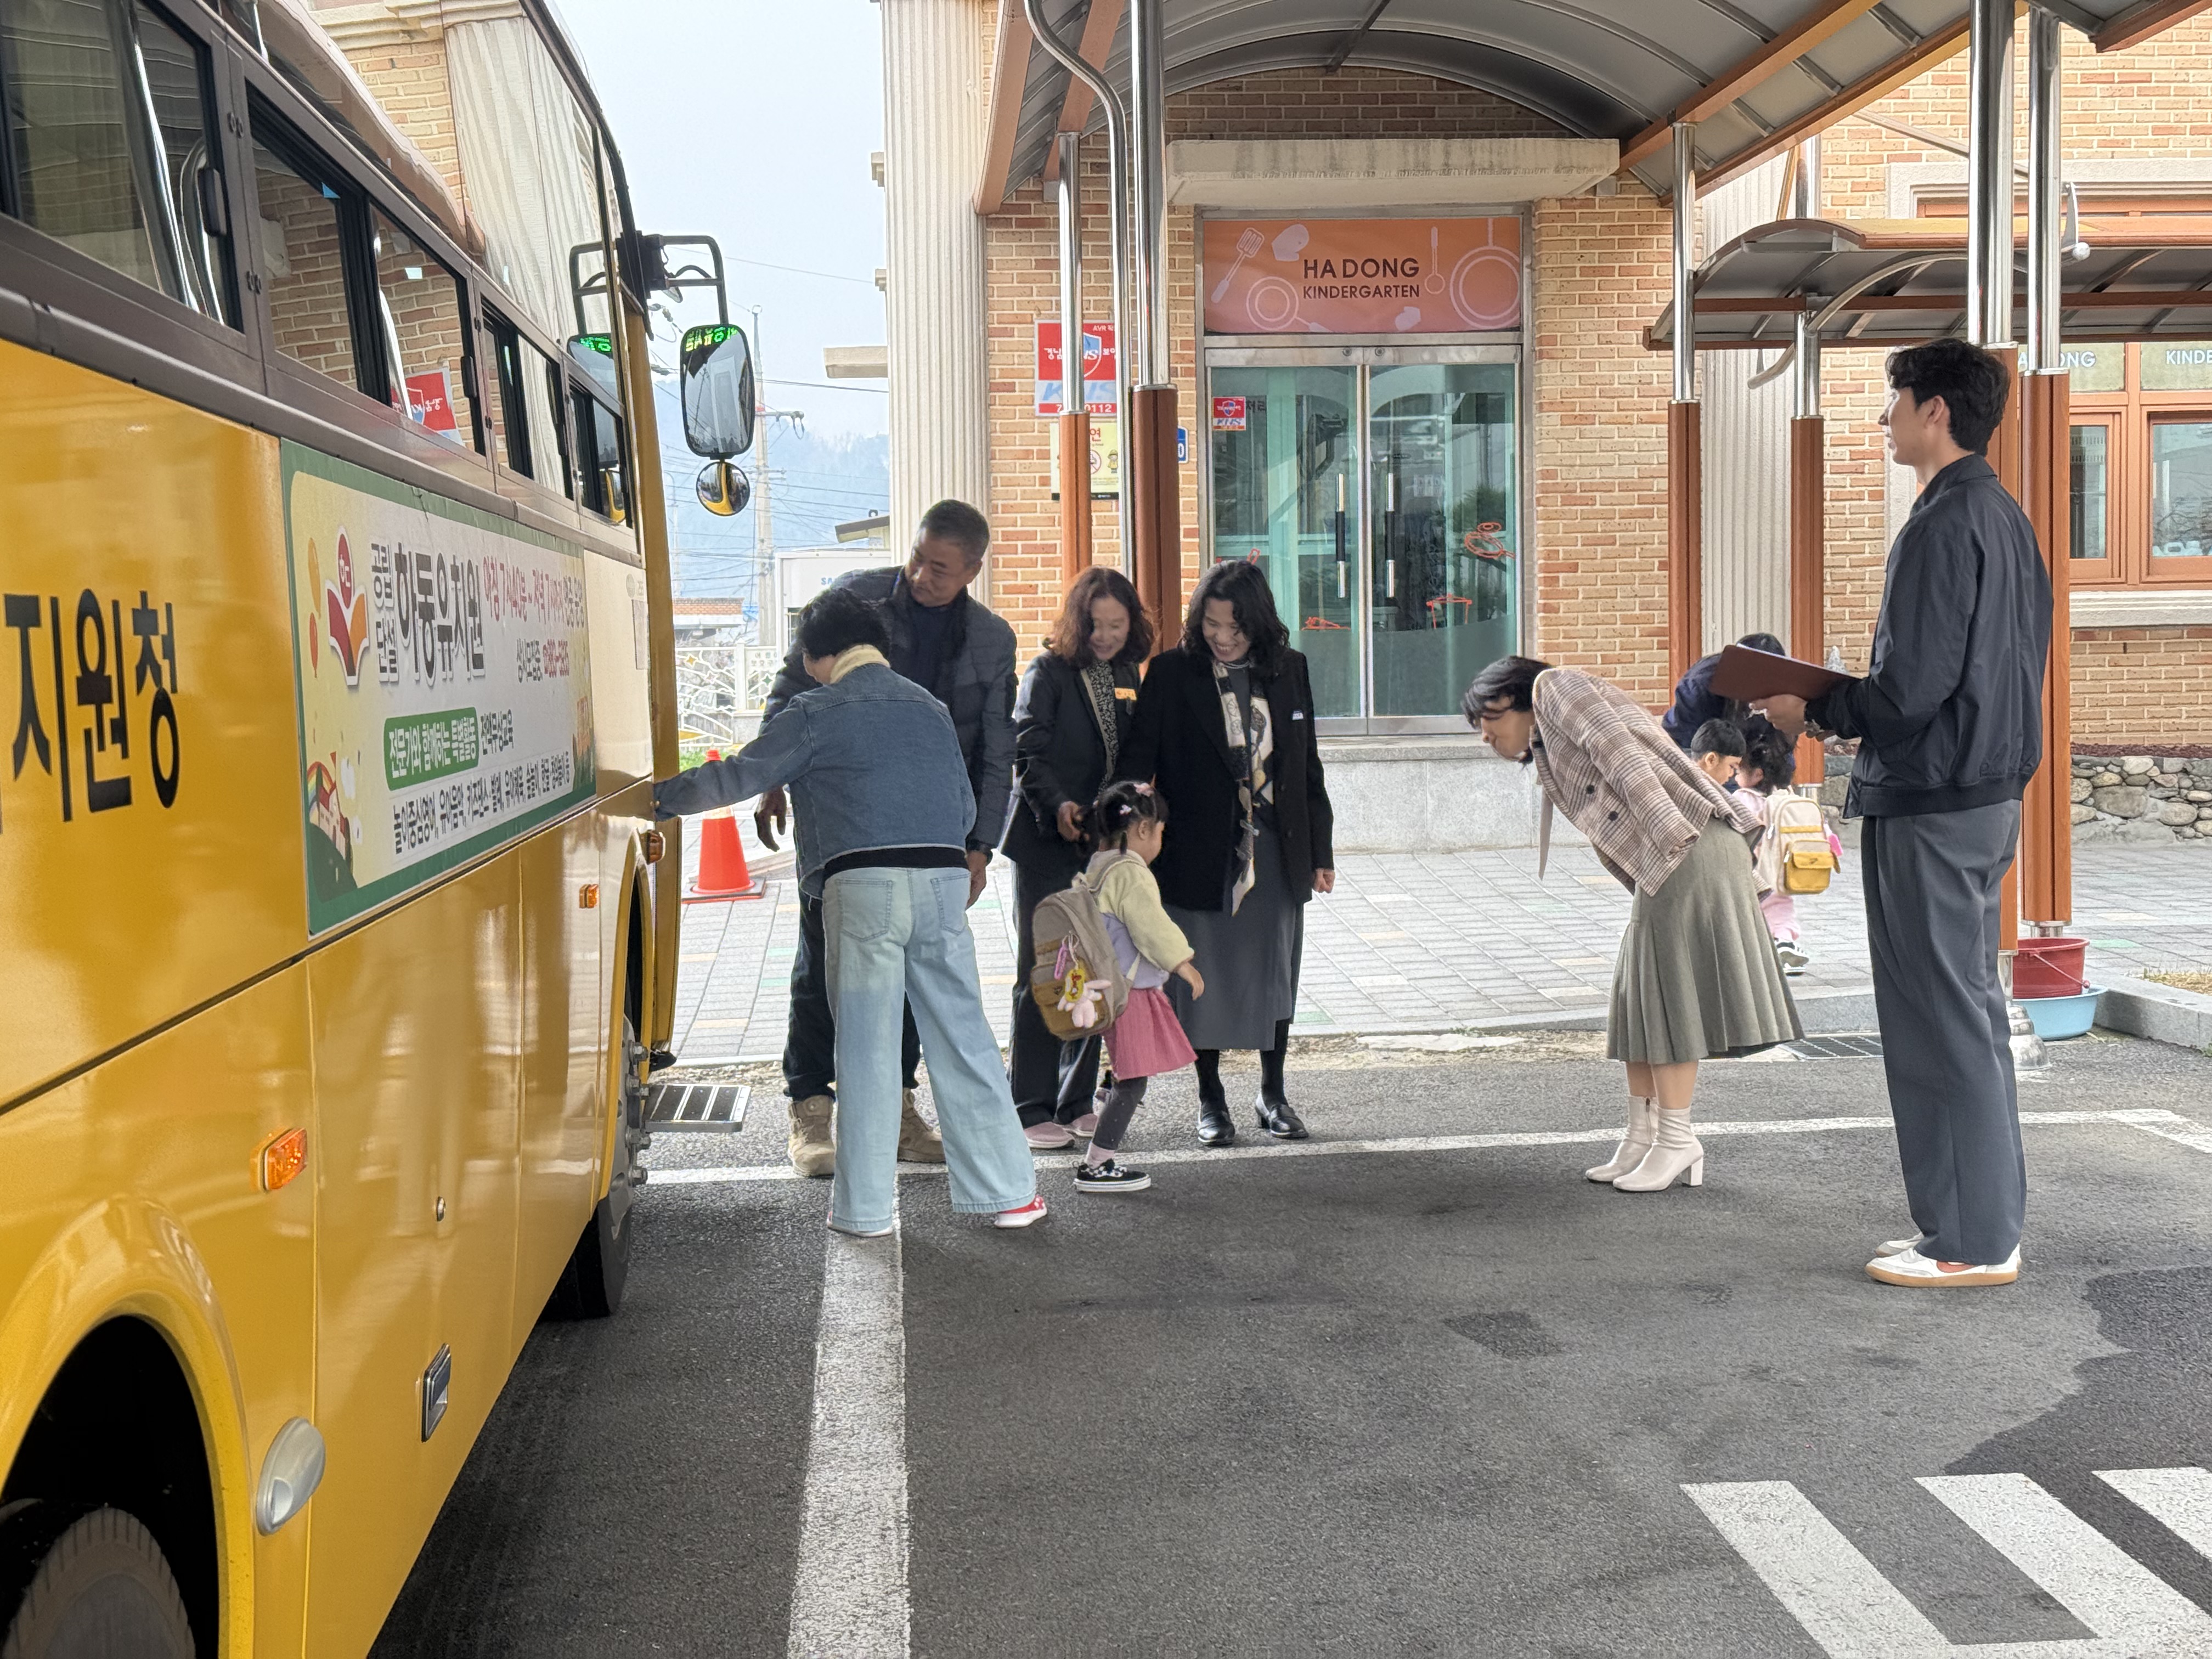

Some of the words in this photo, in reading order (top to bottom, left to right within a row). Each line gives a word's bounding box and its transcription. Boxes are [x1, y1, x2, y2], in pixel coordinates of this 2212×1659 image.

[1304, 284, 1420, 299] KINDERGARTEN
[371, 543, 393, 605] 공립
[483, 555, 500, 622] 아침
[394, 543, 485, 679] 하동유치원
[376, 618, 398, 674] 단설
[0, 588, 180, 828] 지원청
[389, 725, 422, 778] 전문가와
[422, 721, 451, 772] 함께하는
[451, 716, 476, 763] 특별활동
